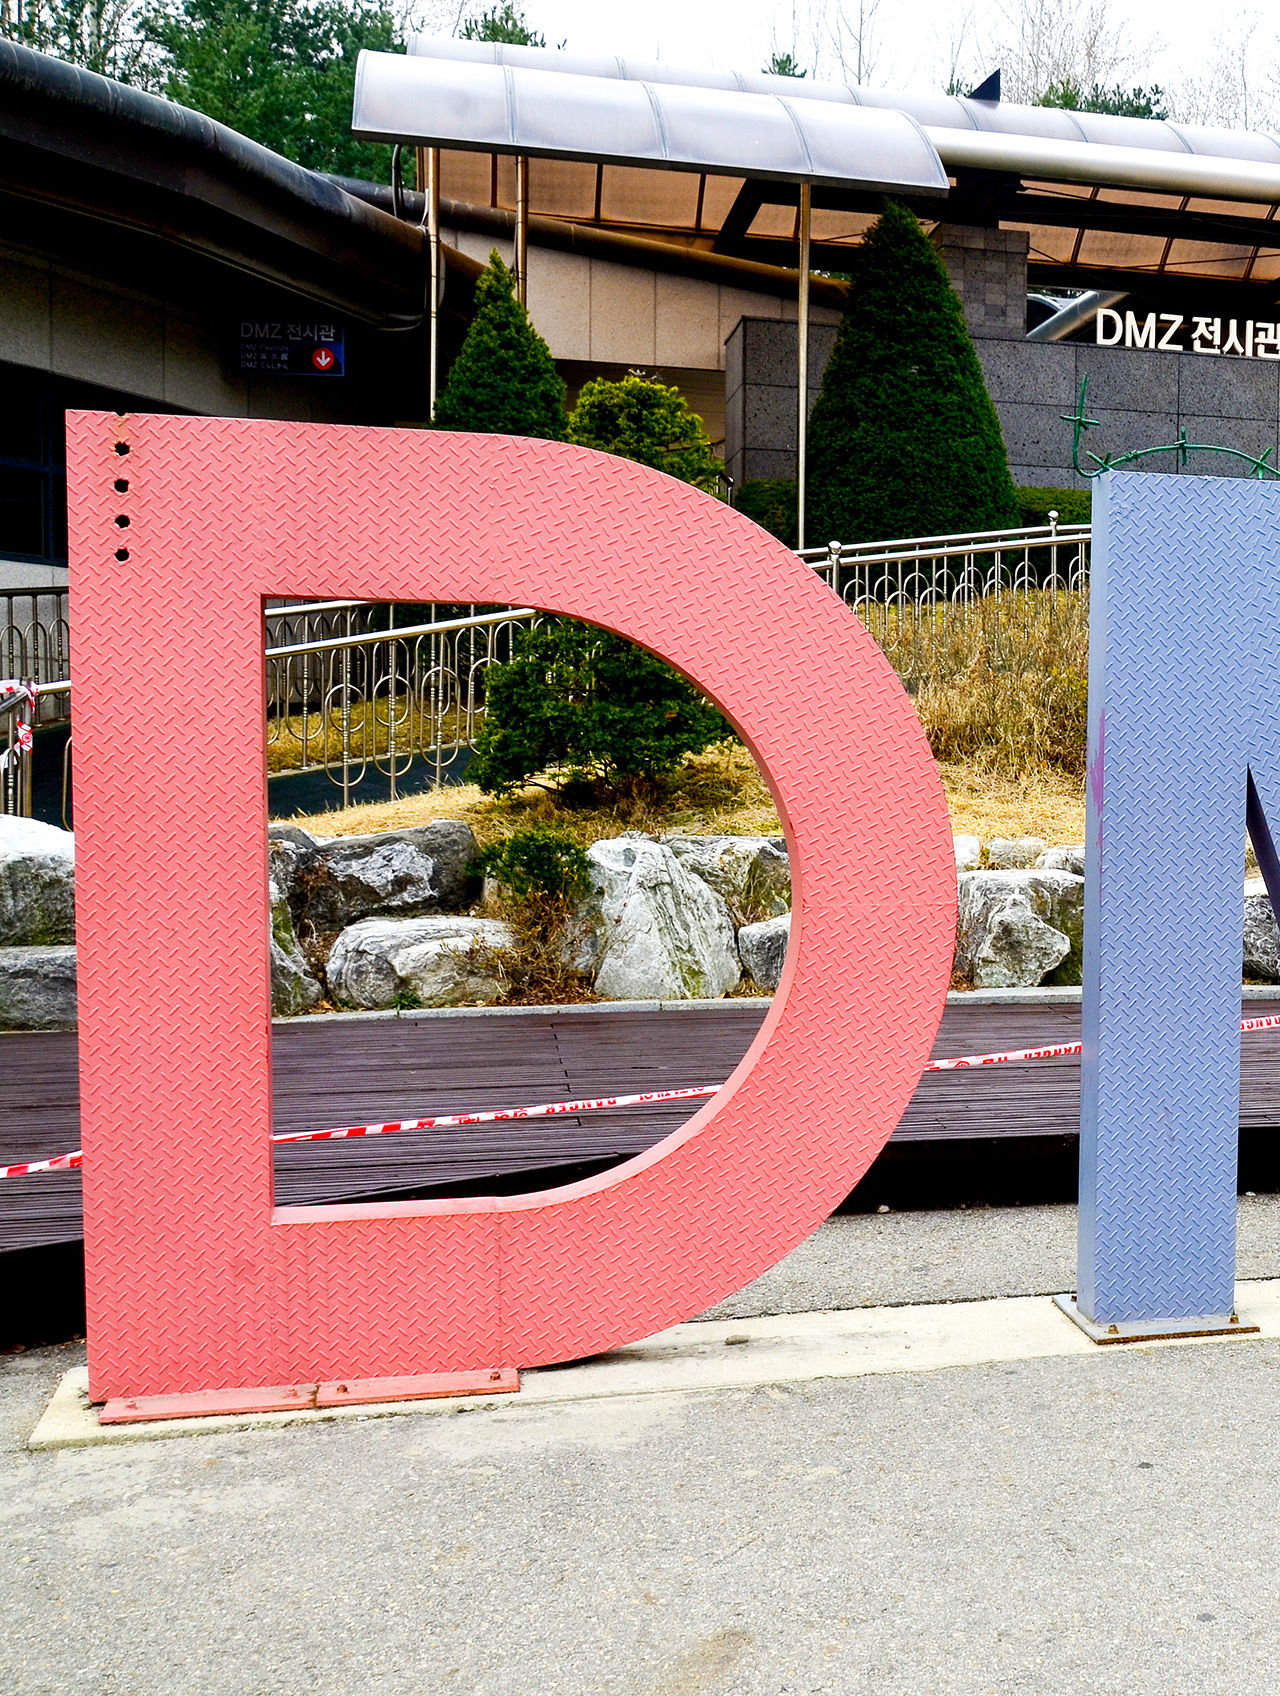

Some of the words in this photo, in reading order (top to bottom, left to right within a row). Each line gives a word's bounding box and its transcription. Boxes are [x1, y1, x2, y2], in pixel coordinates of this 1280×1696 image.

[240, 322, 282, 339] DMZ
[286, 323, 336, 342] 전시관
[1096, 308, 1184, 351] DMZ
[240, 361, 258, 369] DMZ
